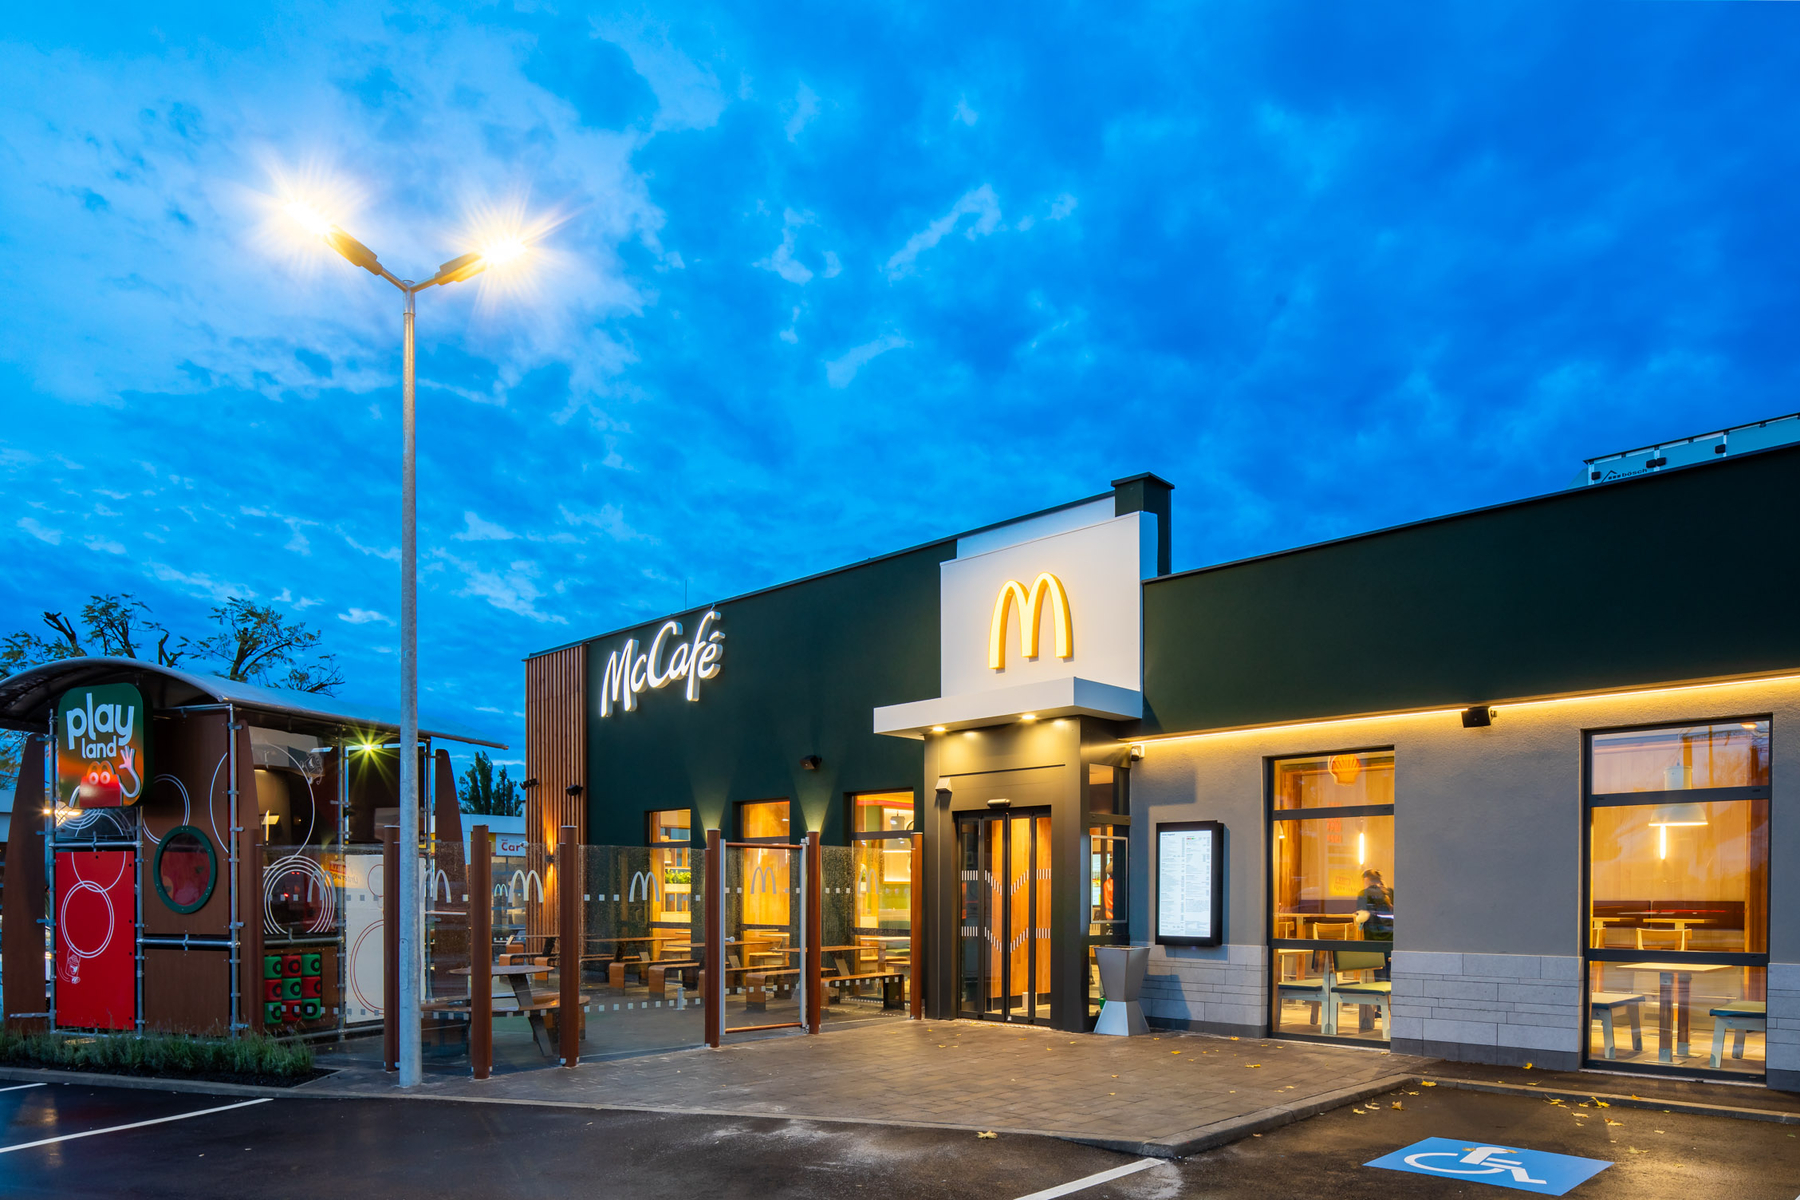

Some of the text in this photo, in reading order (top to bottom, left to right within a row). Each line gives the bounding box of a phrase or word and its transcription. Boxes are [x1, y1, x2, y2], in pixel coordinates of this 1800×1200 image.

[1621, 468, 1648, 477] bösch
[600, 610, 725, 718] McCafé
[66, 692, 134, 750] play
[81, 735, 117, 759] land
